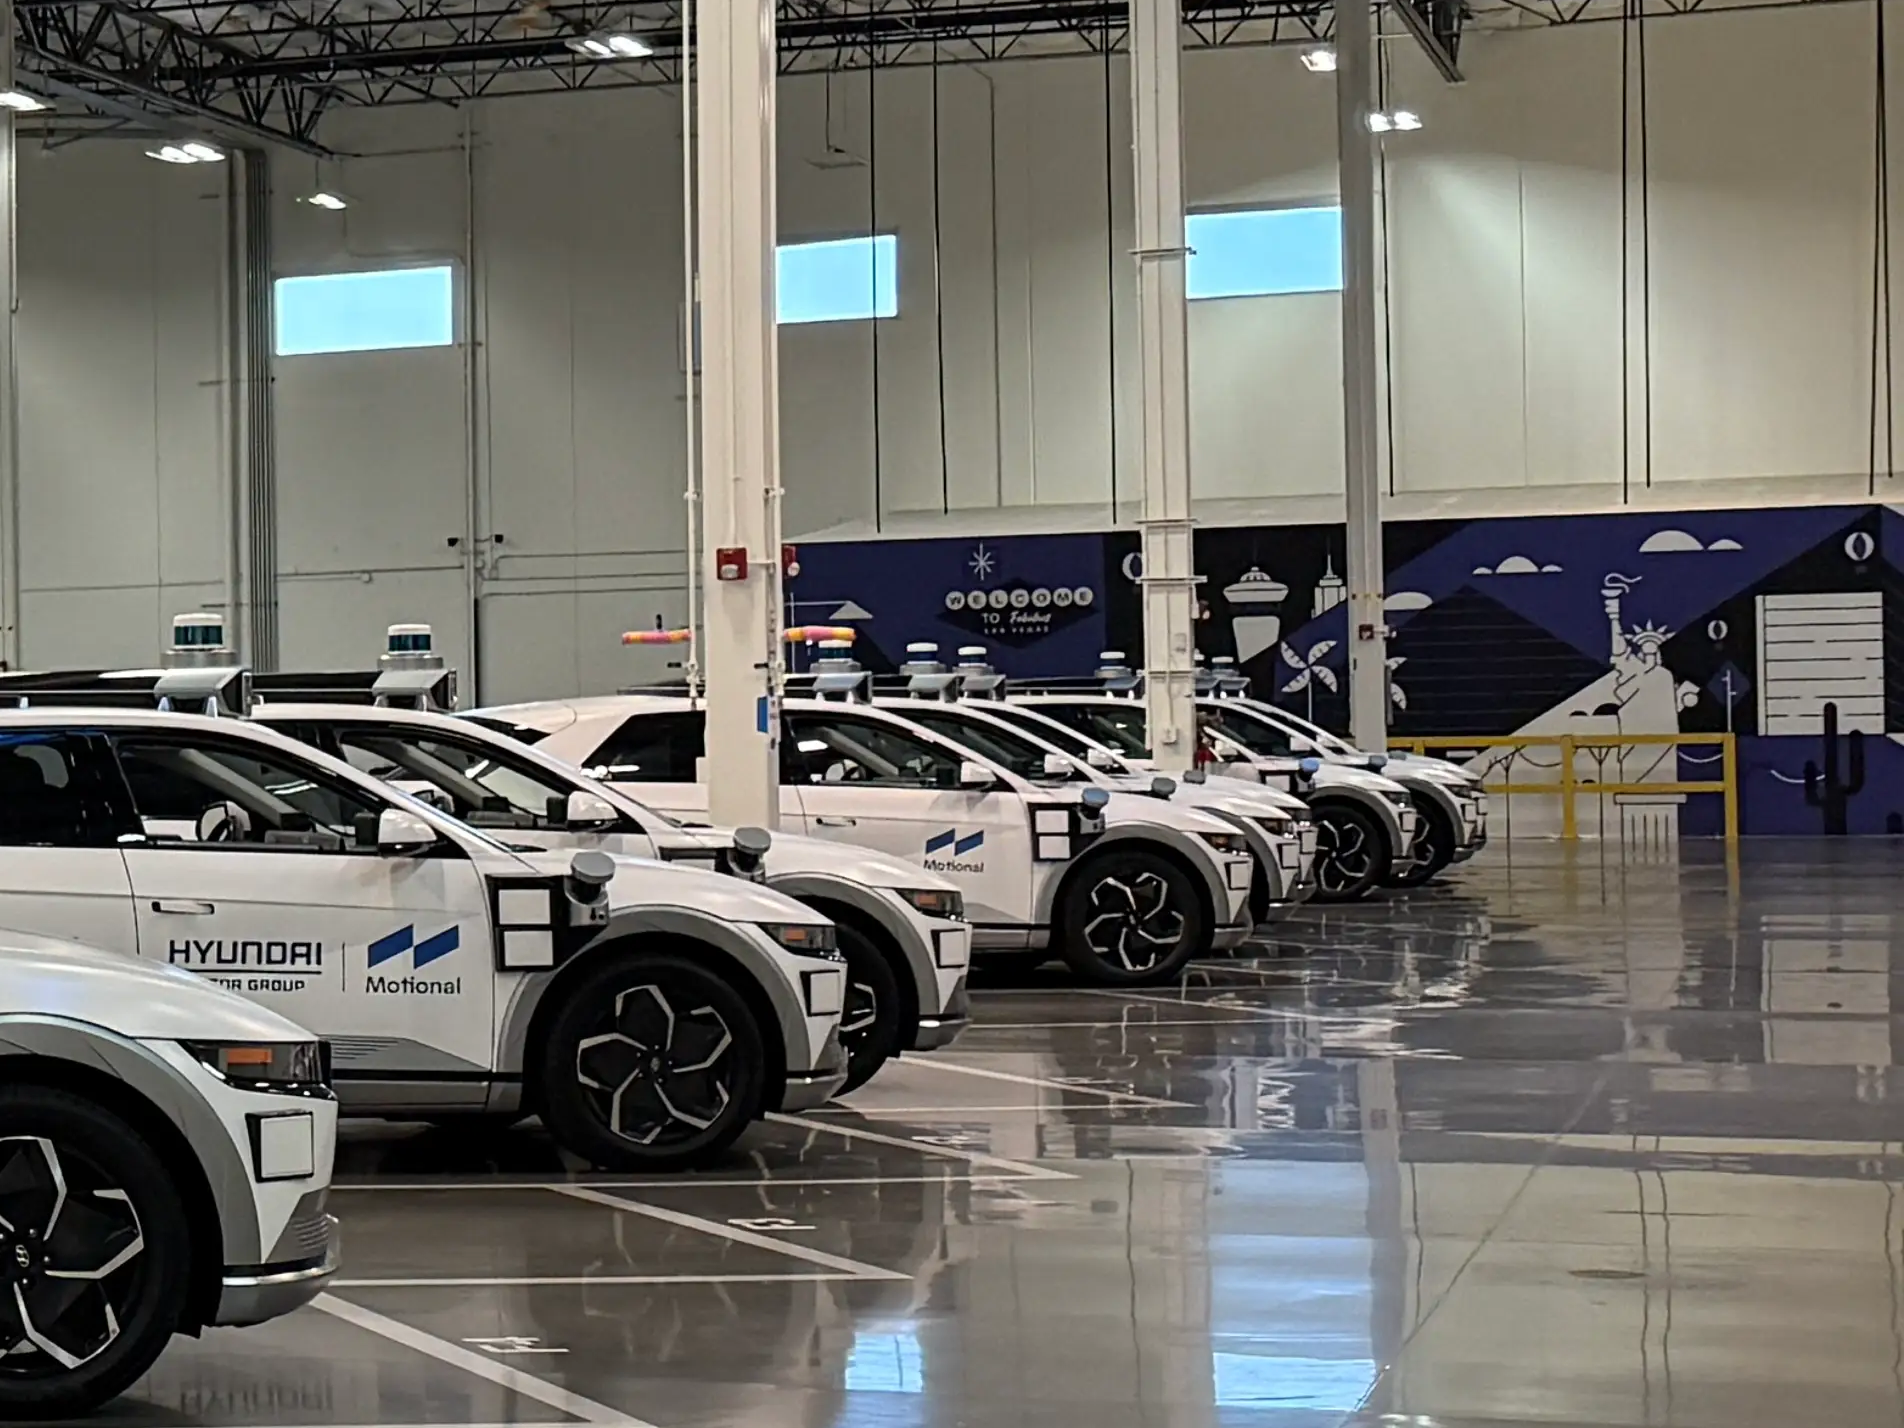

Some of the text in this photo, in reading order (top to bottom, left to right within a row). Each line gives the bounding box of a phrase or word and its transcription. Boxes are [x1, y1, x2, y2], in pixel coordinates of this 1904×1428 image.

[946, 588, 1092, 609] WELCOME
[981, 612, 1001, 623] TO
[169, 939, 322, 966] HYUNDAI
[247, 978, 305, 992] GROUP
[365, 975, 461, 995] Motional
